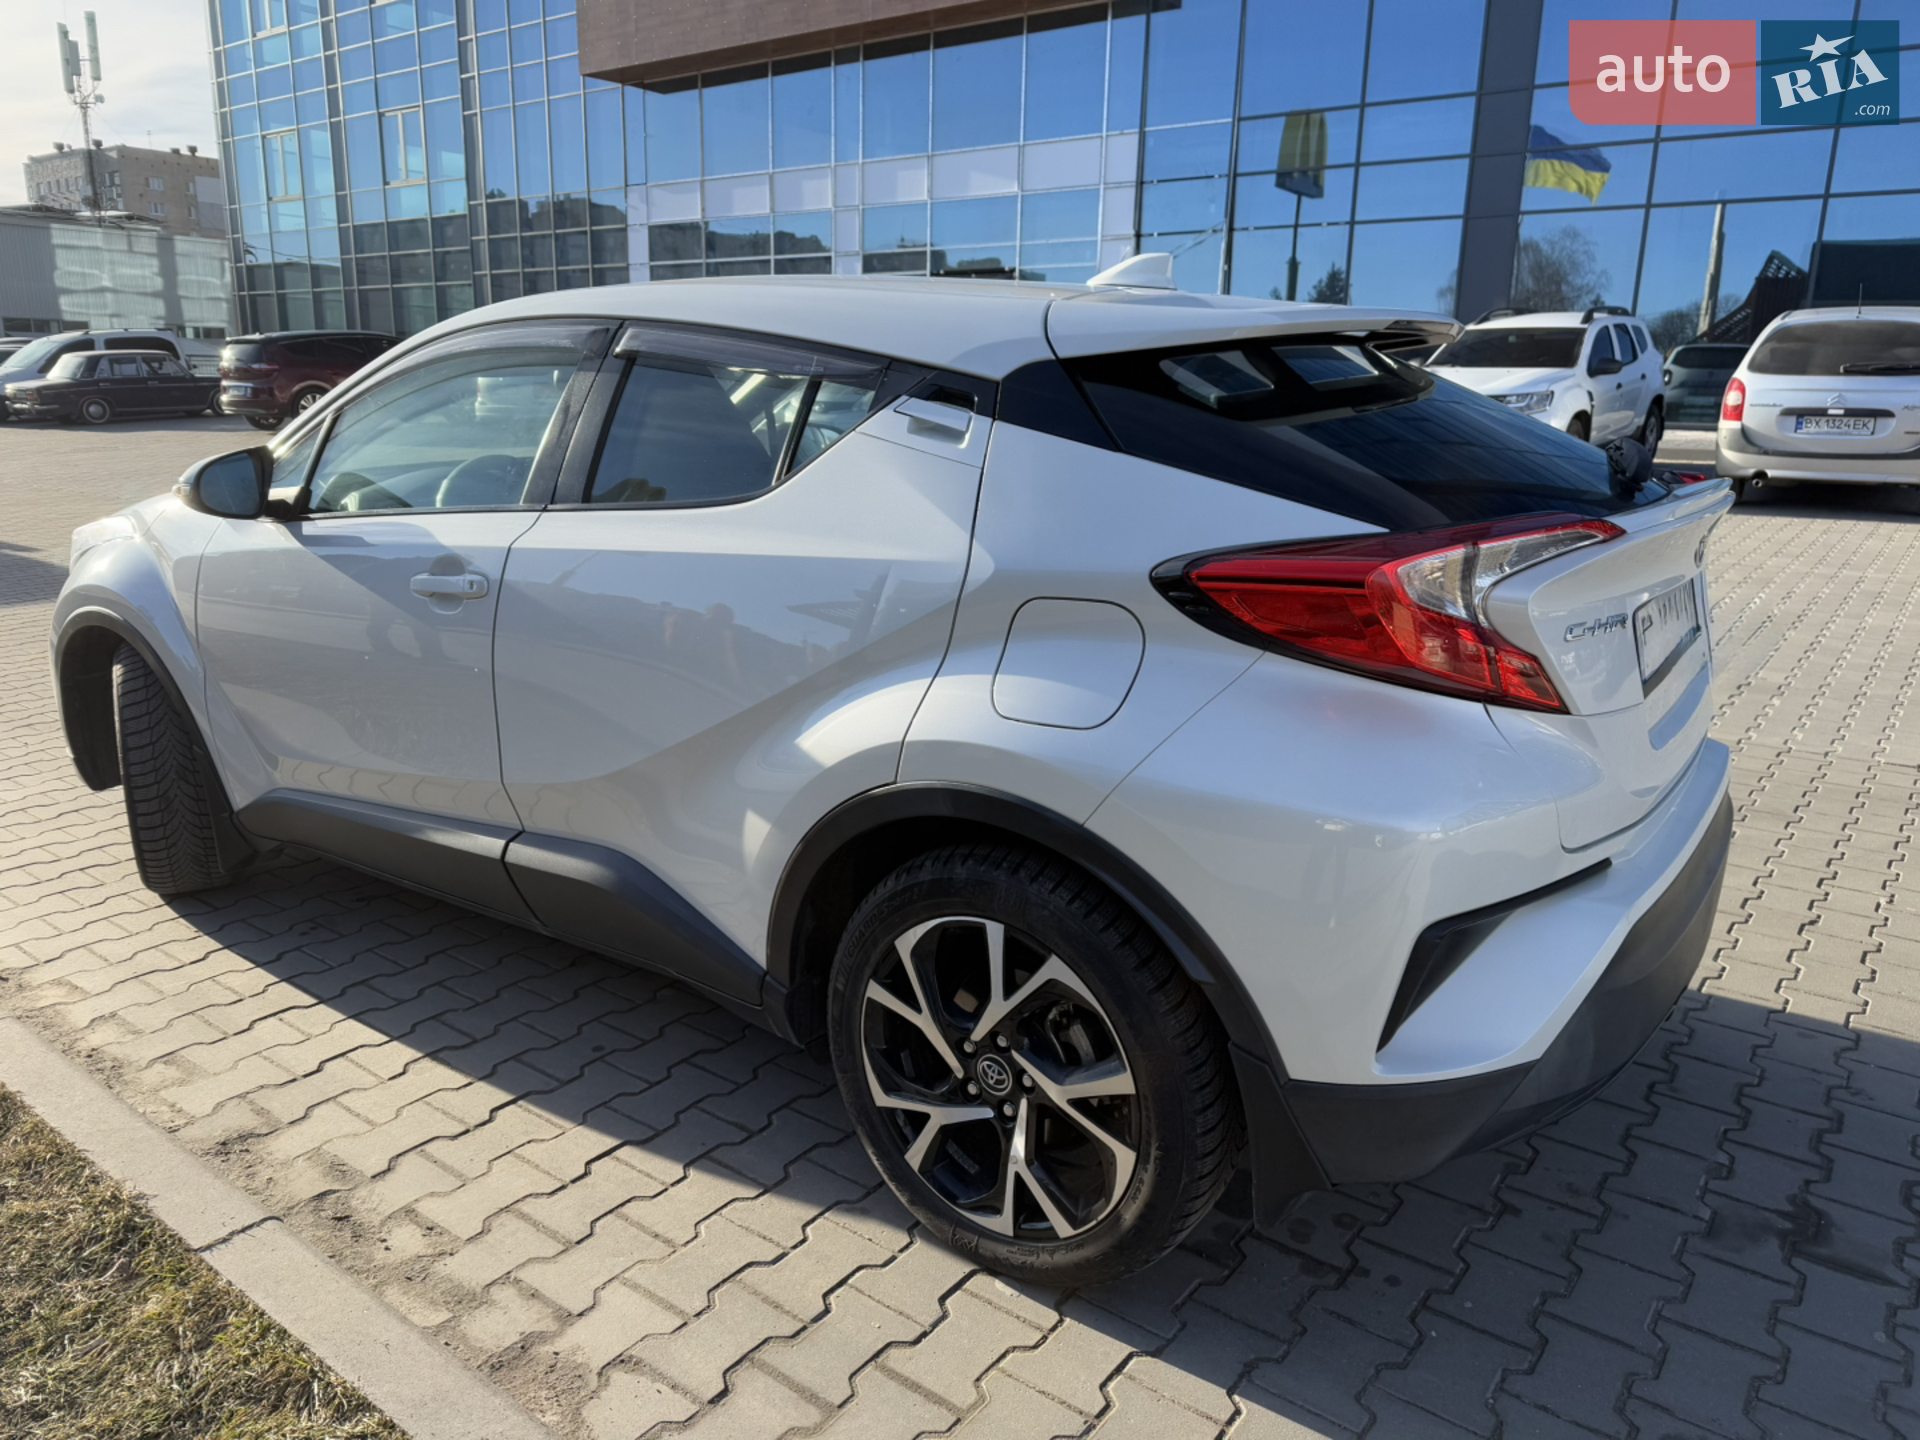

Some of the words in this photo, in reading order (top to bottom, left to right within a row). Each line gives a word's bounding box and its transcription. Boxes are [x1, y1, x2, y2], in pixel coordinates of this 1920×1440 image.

[1804, 418, 1822, 429] BX
[1824, 418, 1851, 430] 1324
[1852, 419, 1871, 431] EK
[1563, 612, 1629, 643] C-HR
